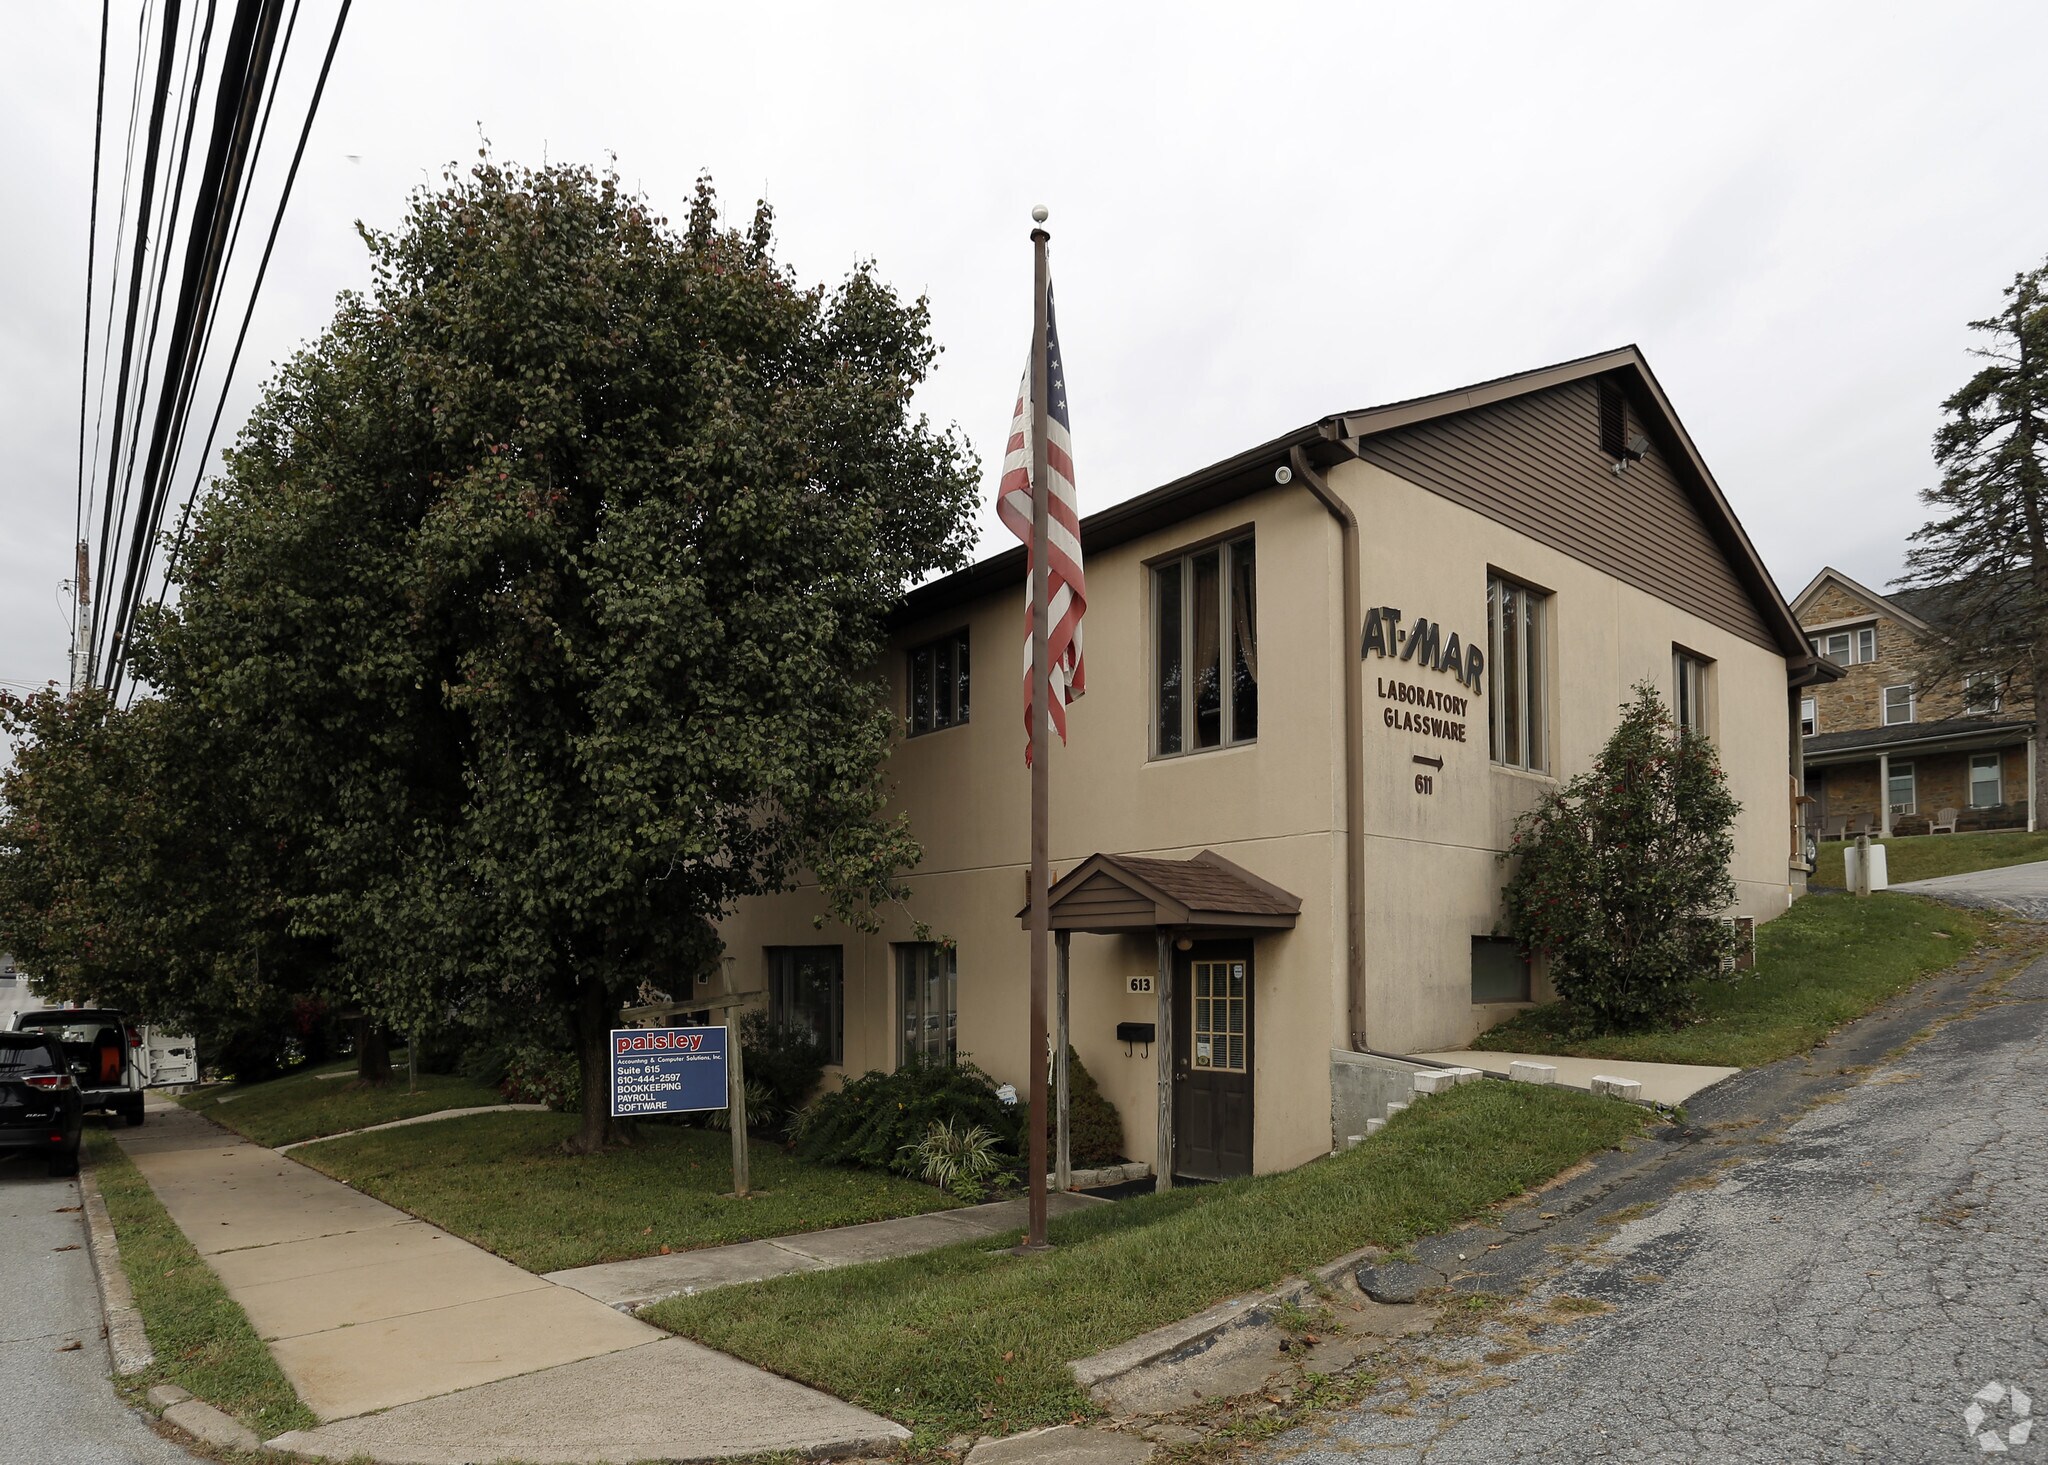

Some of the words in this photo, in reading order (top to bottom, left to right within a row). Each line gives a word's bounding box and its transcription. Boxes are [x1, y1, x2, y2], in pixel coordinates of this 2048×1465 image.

[1378, 677, 1468, 717] LABORATORY
[1384, 707, 1466, 743] GLASSWARE
[1414, 774, 1433, 795] 611
[1130, 978, 1151, 992] 613
[617, 1031, 703, 1054] paisley
[617, 1066, 641, 1075] Suite
[644, 1065, 660, 1073] 615
[617, 1073, 681, 1084] 610-444-2597
[617, 1082, 681, 1094] BOOKKEEPING
[617, 1093, 656, 1103] PAYROLL
[617, 1101, 667, 1112] SOFTWARE
